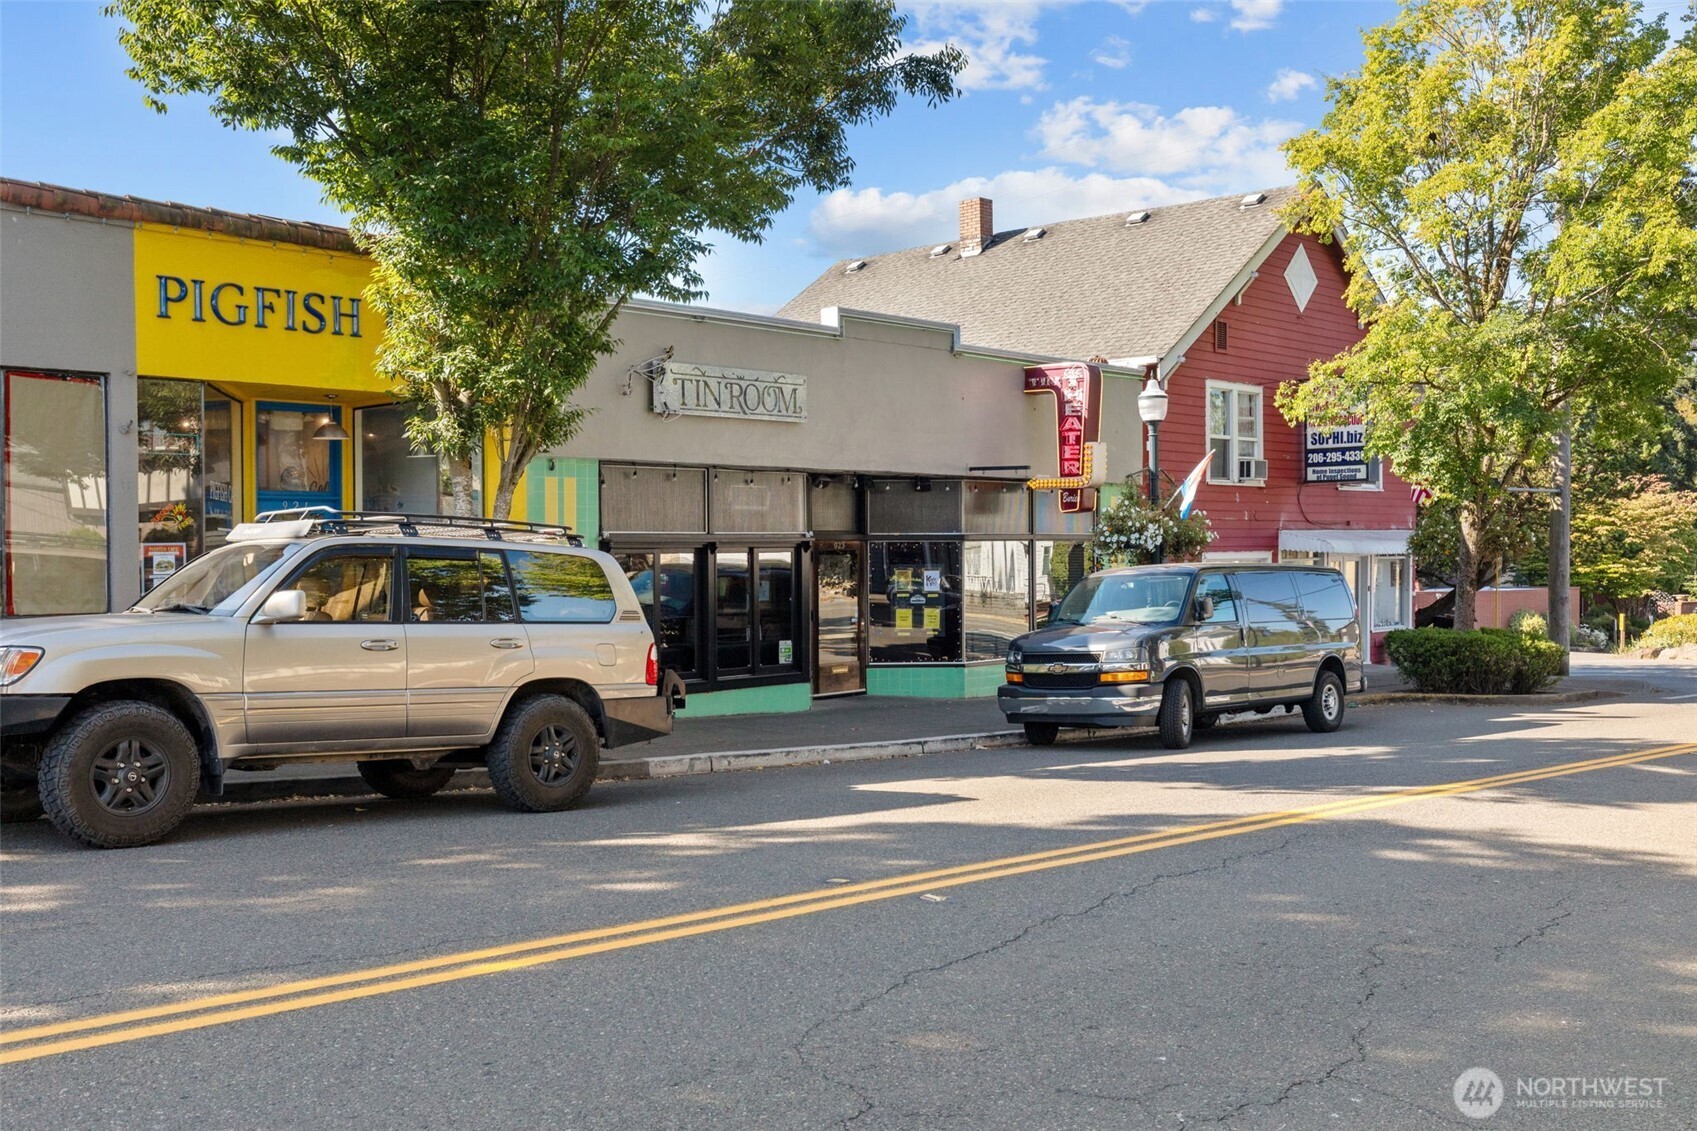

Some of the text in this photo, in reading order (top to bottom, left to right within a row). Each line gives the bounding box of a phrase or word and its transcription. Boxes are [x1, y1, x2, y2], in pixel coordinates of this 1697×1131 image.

[156, 274, 362, 338] PIGFISH
[672, 377, 803, 416] TIN ROOM
[1059, 375, 1083, 474] THEATER
[1310, 430, 1363, 446] SOPHI.biz
[1328, 467, 1362, 475] Inspections
